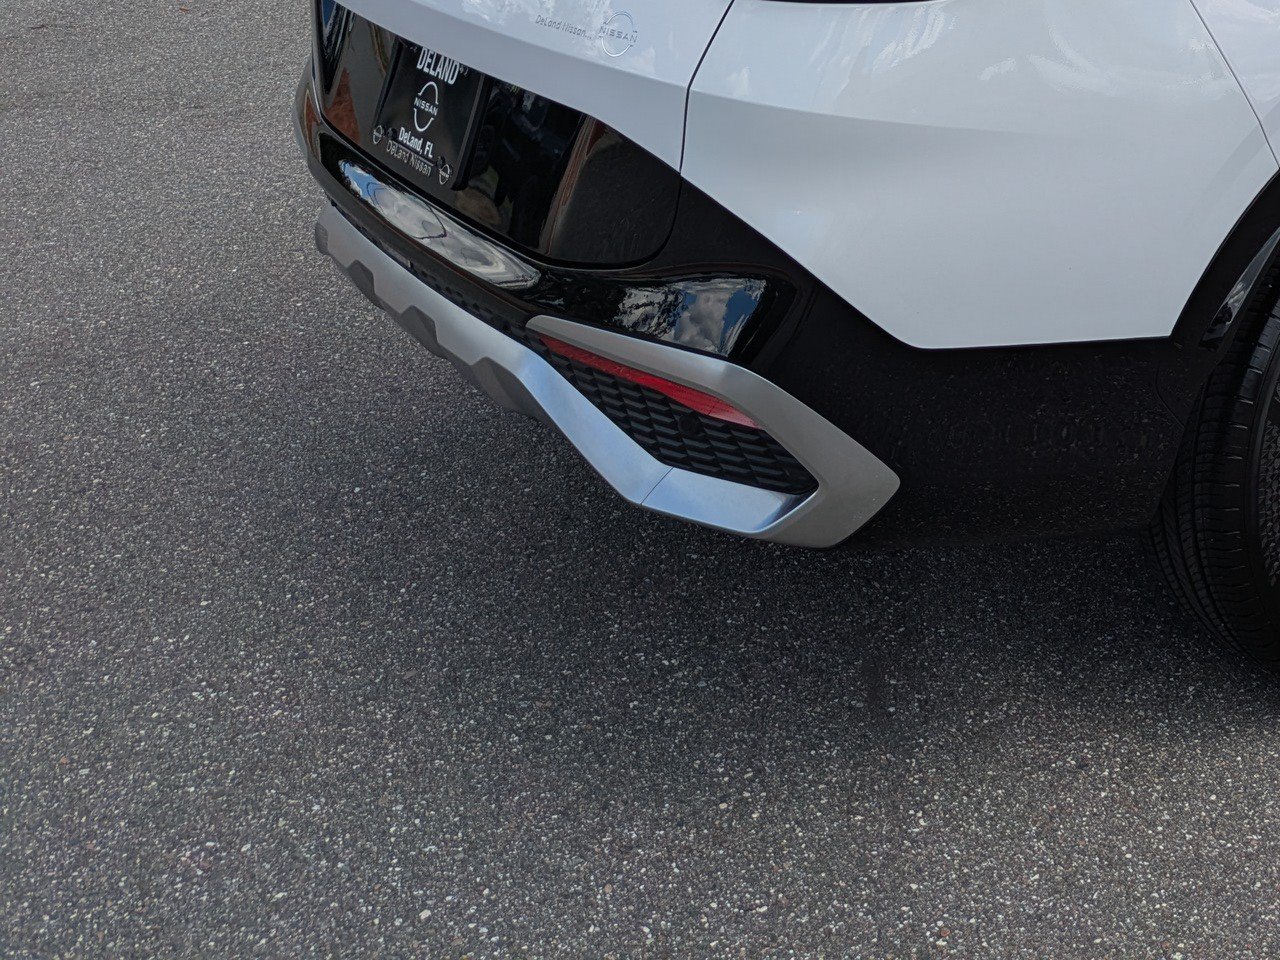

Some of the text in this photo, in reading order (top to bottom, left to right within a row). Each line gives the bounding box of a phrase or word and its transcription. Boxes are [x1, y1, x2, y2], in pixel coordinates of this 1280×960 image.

[599, 25, 637, 43] NISSAN
[416, 48, 461, 85] DELAND
[414, 97, 438, 116] NISSAN
[424, 141, 433, 159] FL
